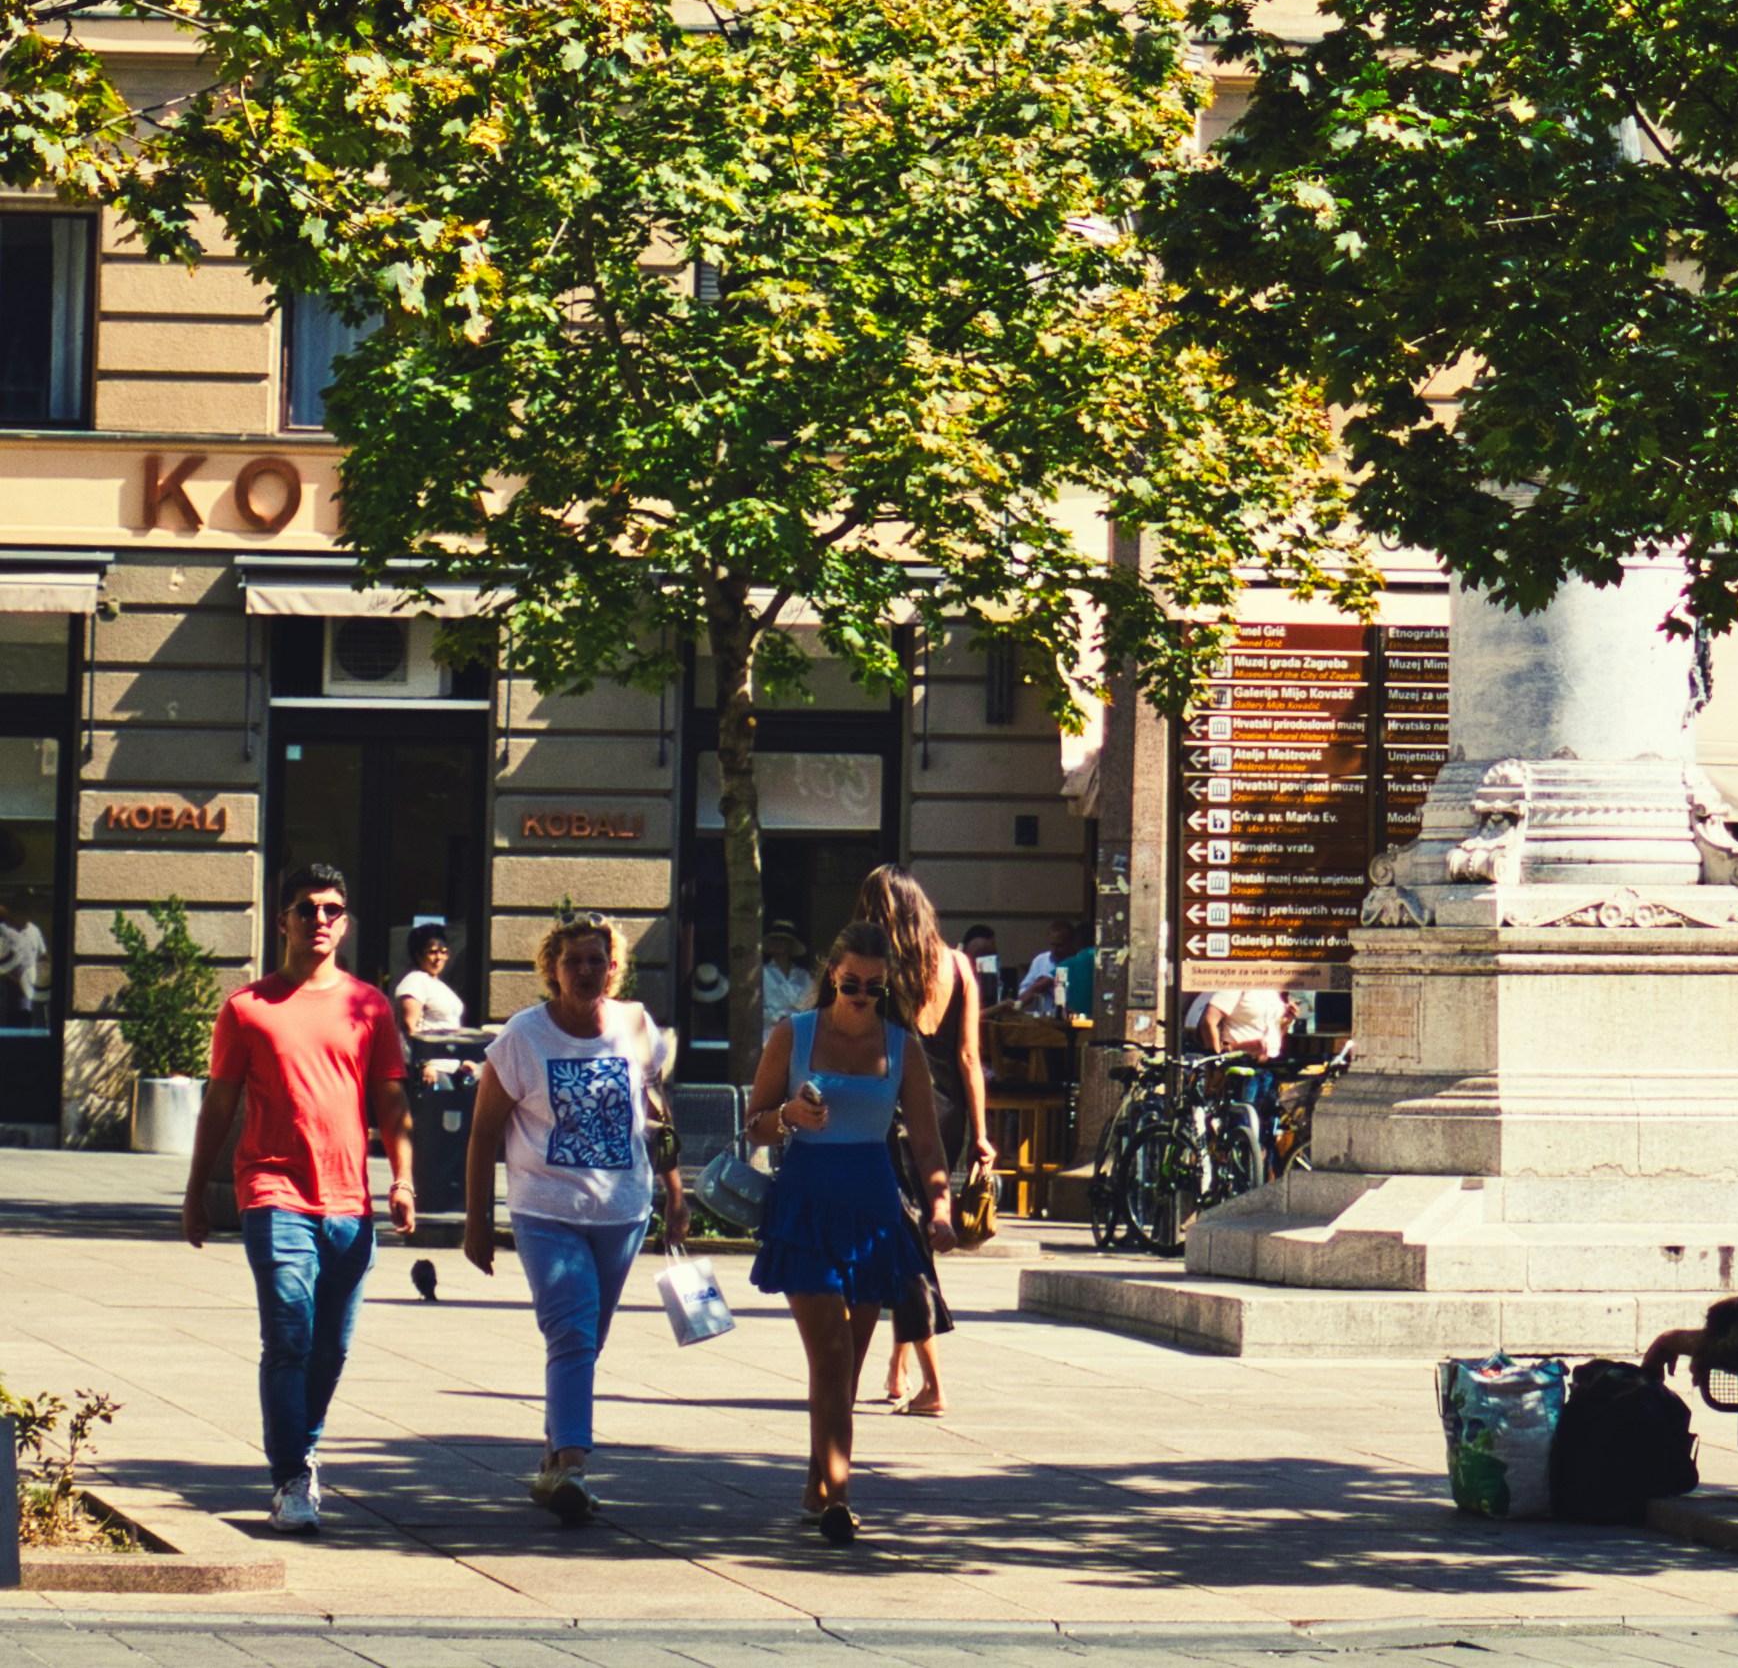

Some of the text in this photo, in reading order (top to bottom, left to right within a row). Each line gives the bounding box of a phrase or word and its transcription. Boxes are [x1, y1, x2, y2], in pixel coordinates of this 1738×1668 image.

[1237, 625, 1262, 637] unel
[1234, 655, 1349, 671] Muzej grada Zagreba
[1388, 659, 1421, 671] Muzej
[1234, 670, 1272, 679] Museum
[1300, 671, 1318, 681] City
[1329, 671, 1361, 681] Zagreb
[1233, 686, 1279, 700] Galerija
[1280, 687, 1307, 701] Mijo
[1388, 689, 1419, 702] Muzej
[1421, 692, 1434, 700] za
[1233, 717, 1365, 732] Hrvatski prirodoslovni muzej
[1387, 720, 1431, 731] Hrvatsko
[1233, 748, 1265, 762] Atelje
[1388, 751, 1445, 763] Umjetnički
[1232, 779, 1364, 794] Hrvatski povijesni muzej
[107, 804, 228, 831] KOBALI
[1232, 810, 1338, 823] Crkva sv. Marka Ev.
[522, 810, 644, 837] KOBALI
[1232, 841, 1315, 853] Kamenita vrata
[1231, 872, 1265, 883] Hrvatski
[1266, 873, 1291, 885] muzej
[1231, 903, 1357, 917] Muzej prekinutih veza
[1231, 935, 1274, 948] Galerija
[1275, 934, 1325, 947] Klovićevi
[1191, 967, 1236, 977] Skenirajte
[1238, 968, 1248, 976] za
